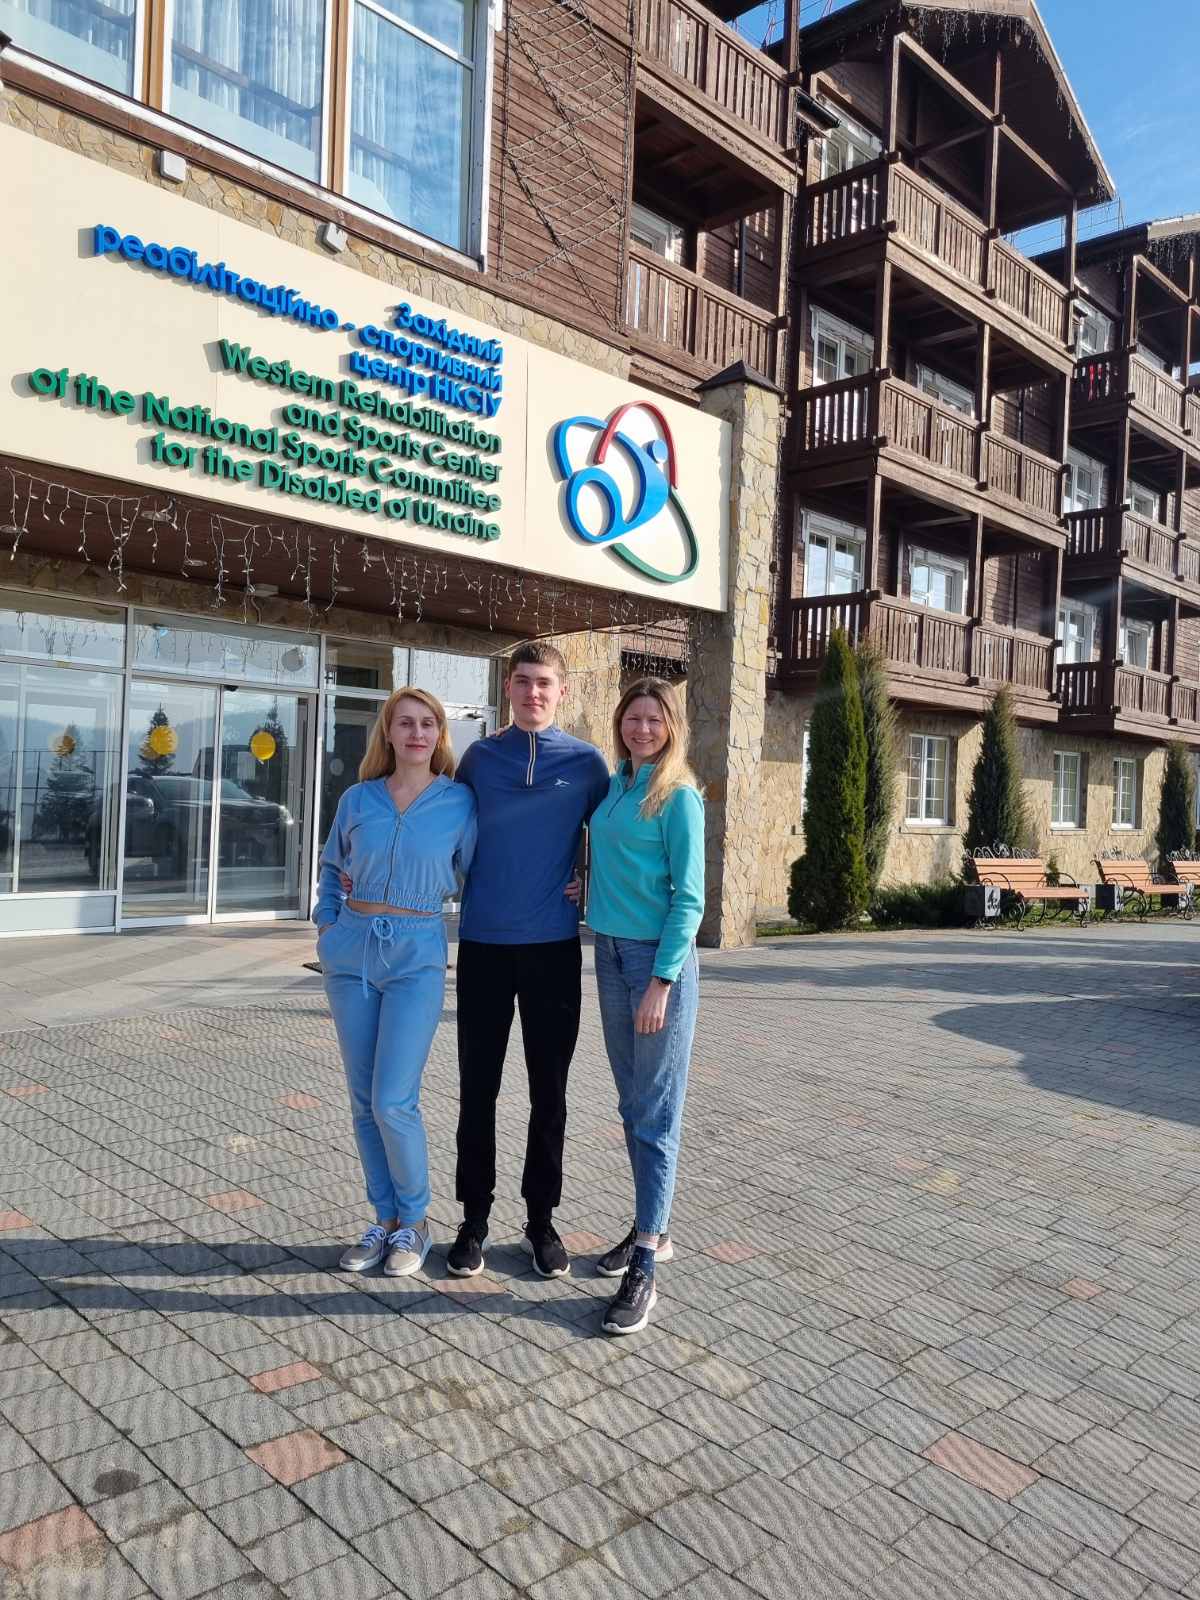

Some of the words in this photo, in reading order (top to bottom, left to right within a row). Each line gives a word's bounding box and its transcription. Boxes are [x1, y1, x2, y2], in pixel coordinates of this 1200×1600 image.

[95, 224, 338, 330] реабілітаційно
[359, 324, 502, 392] спортивний
[395, 302, 503, 364] Західний
[218, 338, 336, 402] Western
[339, 380, 502, 453] Rehabilitation
[350, 351, 429, 397] центр
[430, 375, 502, 417] НКСІУ
[28, 367, 69, 398] of
[74, 372, 136, 415] the
[143, 391, 279, 454] National
[282, 432, 368, 477] Sports
[369, 457, 501, 512] Committee
[151, 431, 197, 468] for
[202, 445, 255, 482] the
[260, 459, 382, 513] Disabled
[384, 496, 413, 519] of
[413, 498, 501, 540] Ukraine
[282, 403, 341, 437] and
[344, 415, 423, 460] Sports
[423, 441, 502, 482] Center
